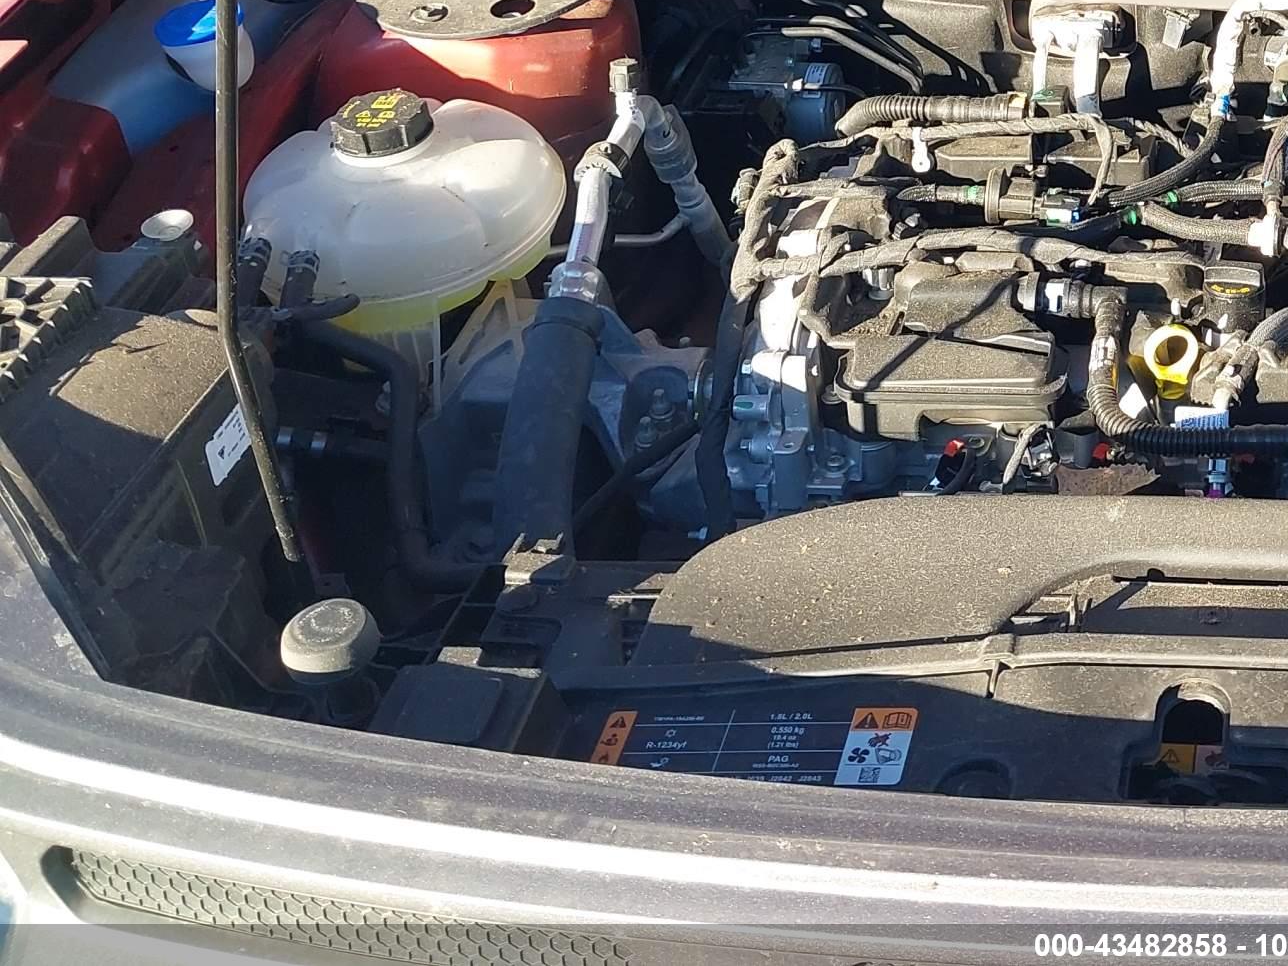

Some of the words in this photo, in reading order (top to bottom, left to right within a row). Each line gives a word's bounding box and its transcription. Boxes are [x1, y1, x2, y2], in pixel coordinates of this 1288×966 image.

[794, 712, 813, 720] 2.0L
[771, 726, 793, 734] 0.550
[794, 726, 805, 735] kg
[645, 741, 687, 750] R-1234yf
[767, 754, 789, 763] PAG
